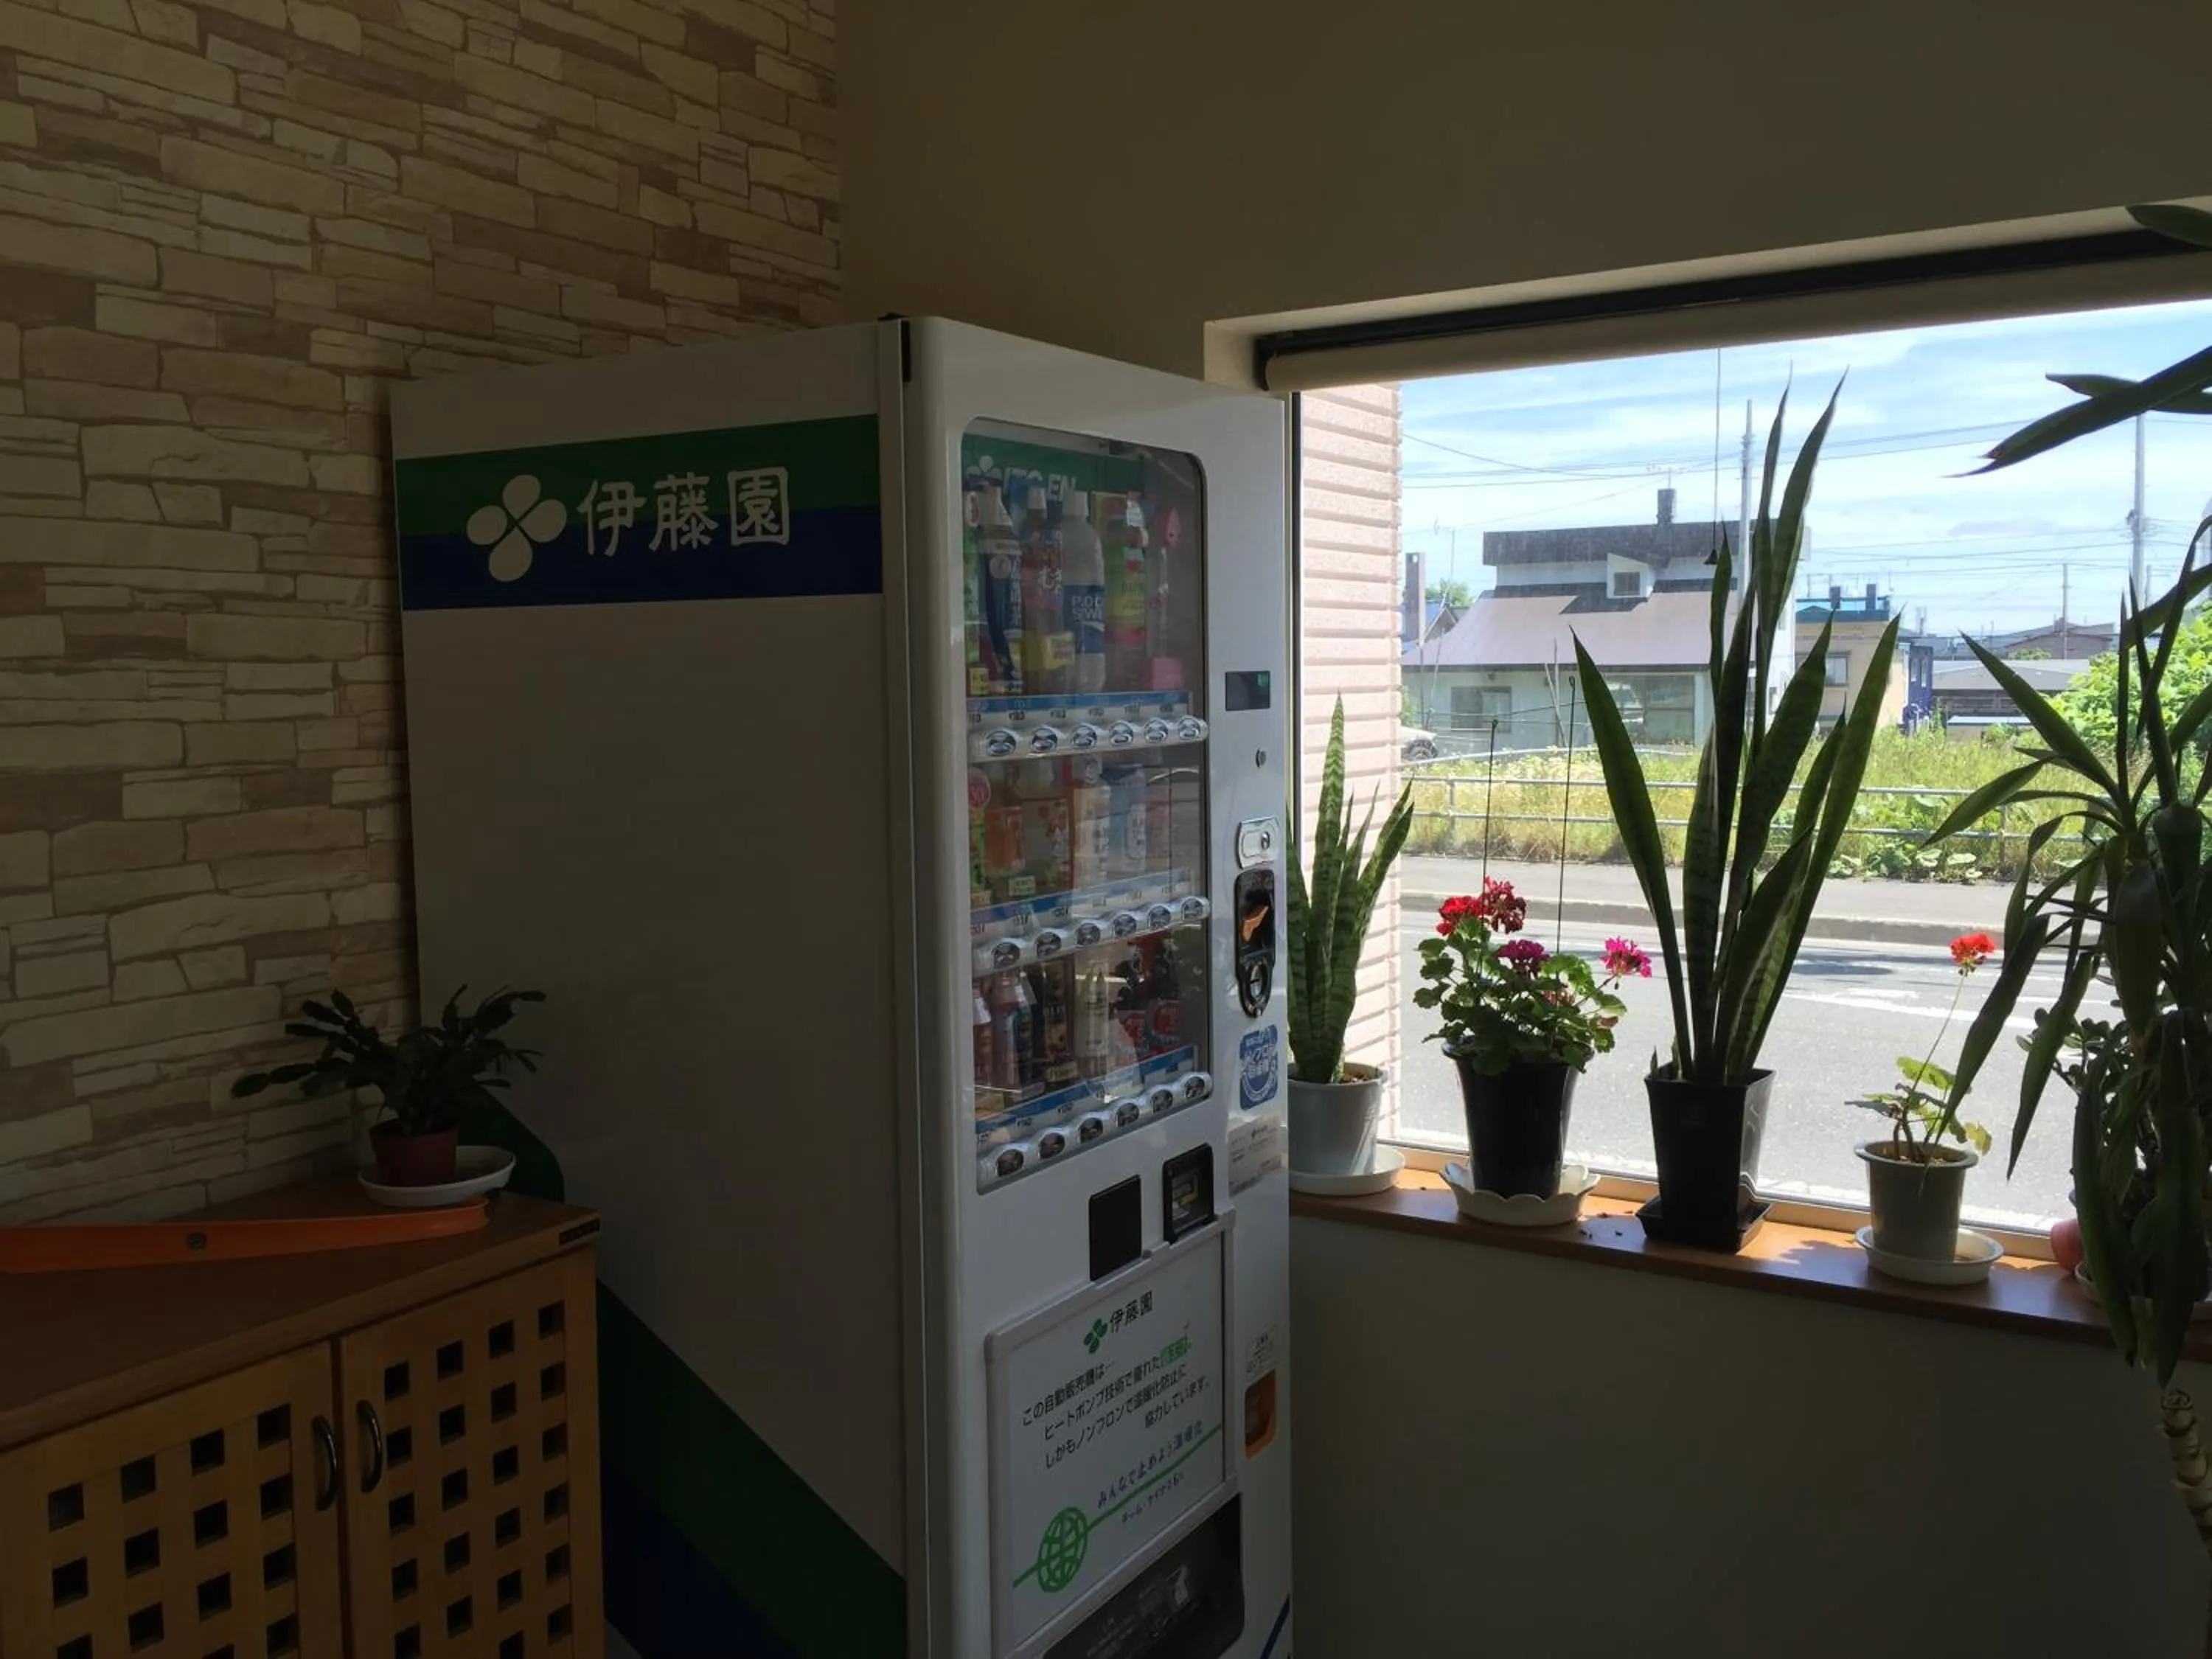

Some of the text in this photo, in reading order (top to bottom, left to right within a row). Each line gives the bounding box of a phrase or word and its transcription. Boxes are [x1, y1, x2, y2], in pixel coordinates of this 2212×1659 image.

[576, 465, 791, 557] 伊藤園
[1109, 1290, 1152, 1334] 伊藤園
